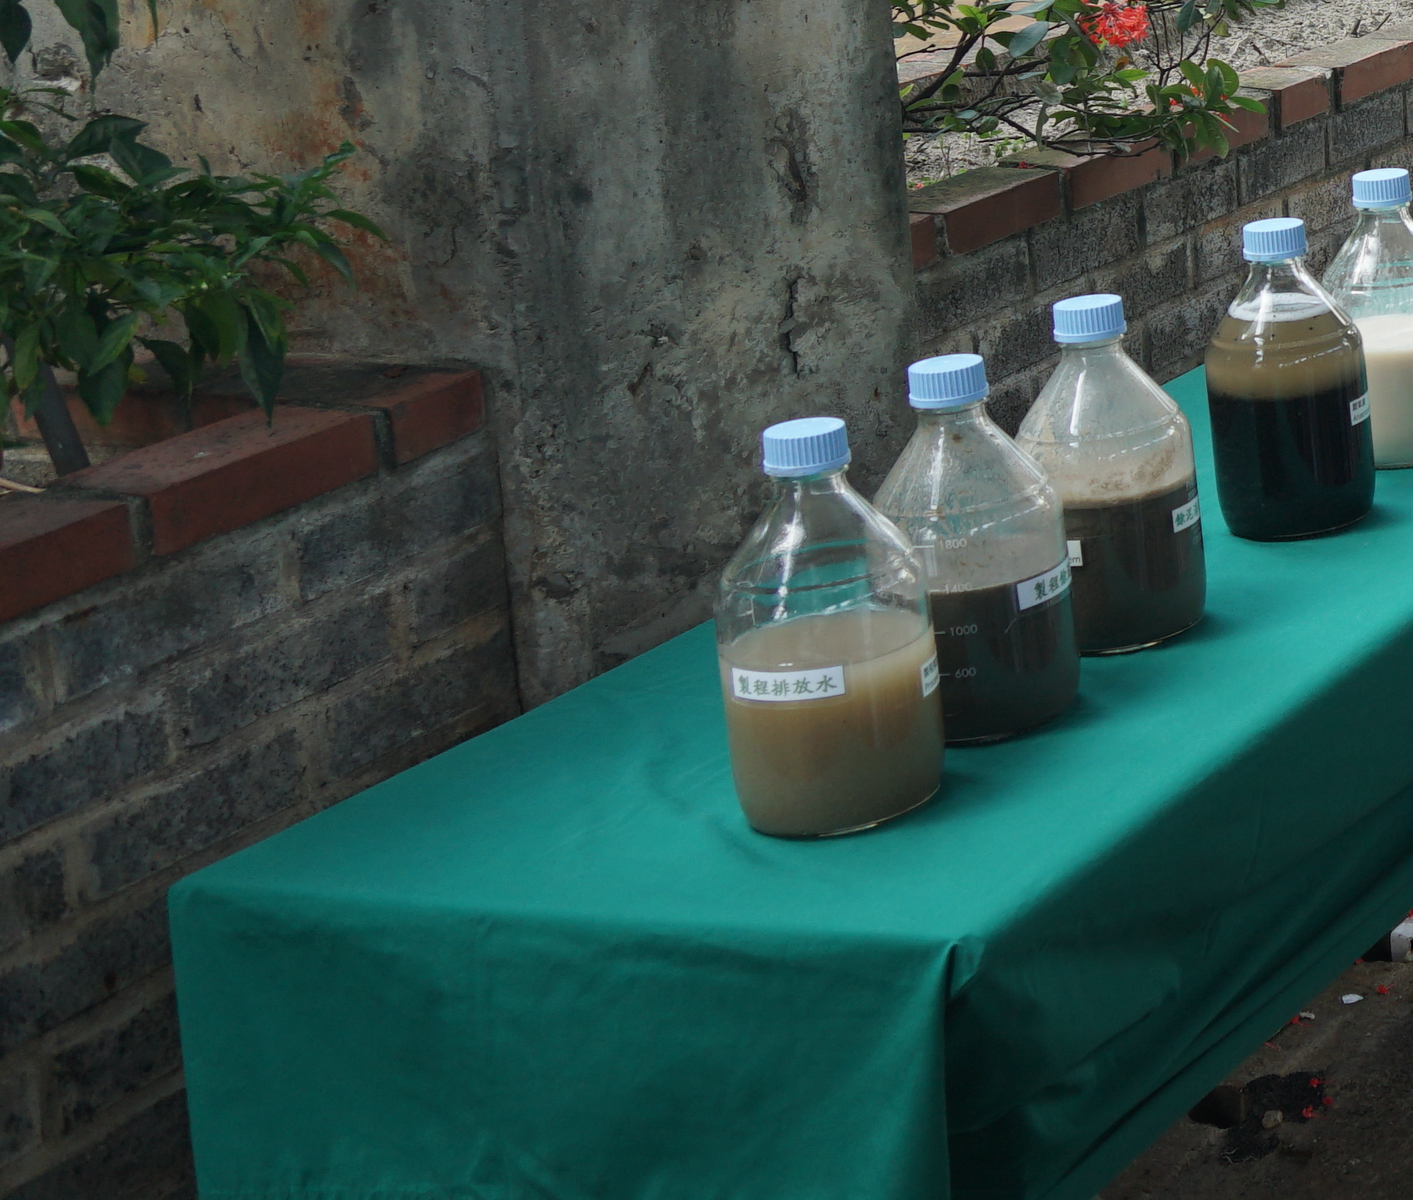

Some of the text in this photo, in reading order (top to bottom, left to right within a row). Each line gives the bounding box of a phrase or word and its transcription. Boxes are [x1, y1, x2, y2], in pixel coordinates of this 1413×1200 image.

[938, 538, 968, 550] 1800
[943, 582, 972, 595] 1400
[949, 624, 978, 637] 1000
[954, 667, 977, 679] 600
[738, 674, 837, 697] 製程排放水
